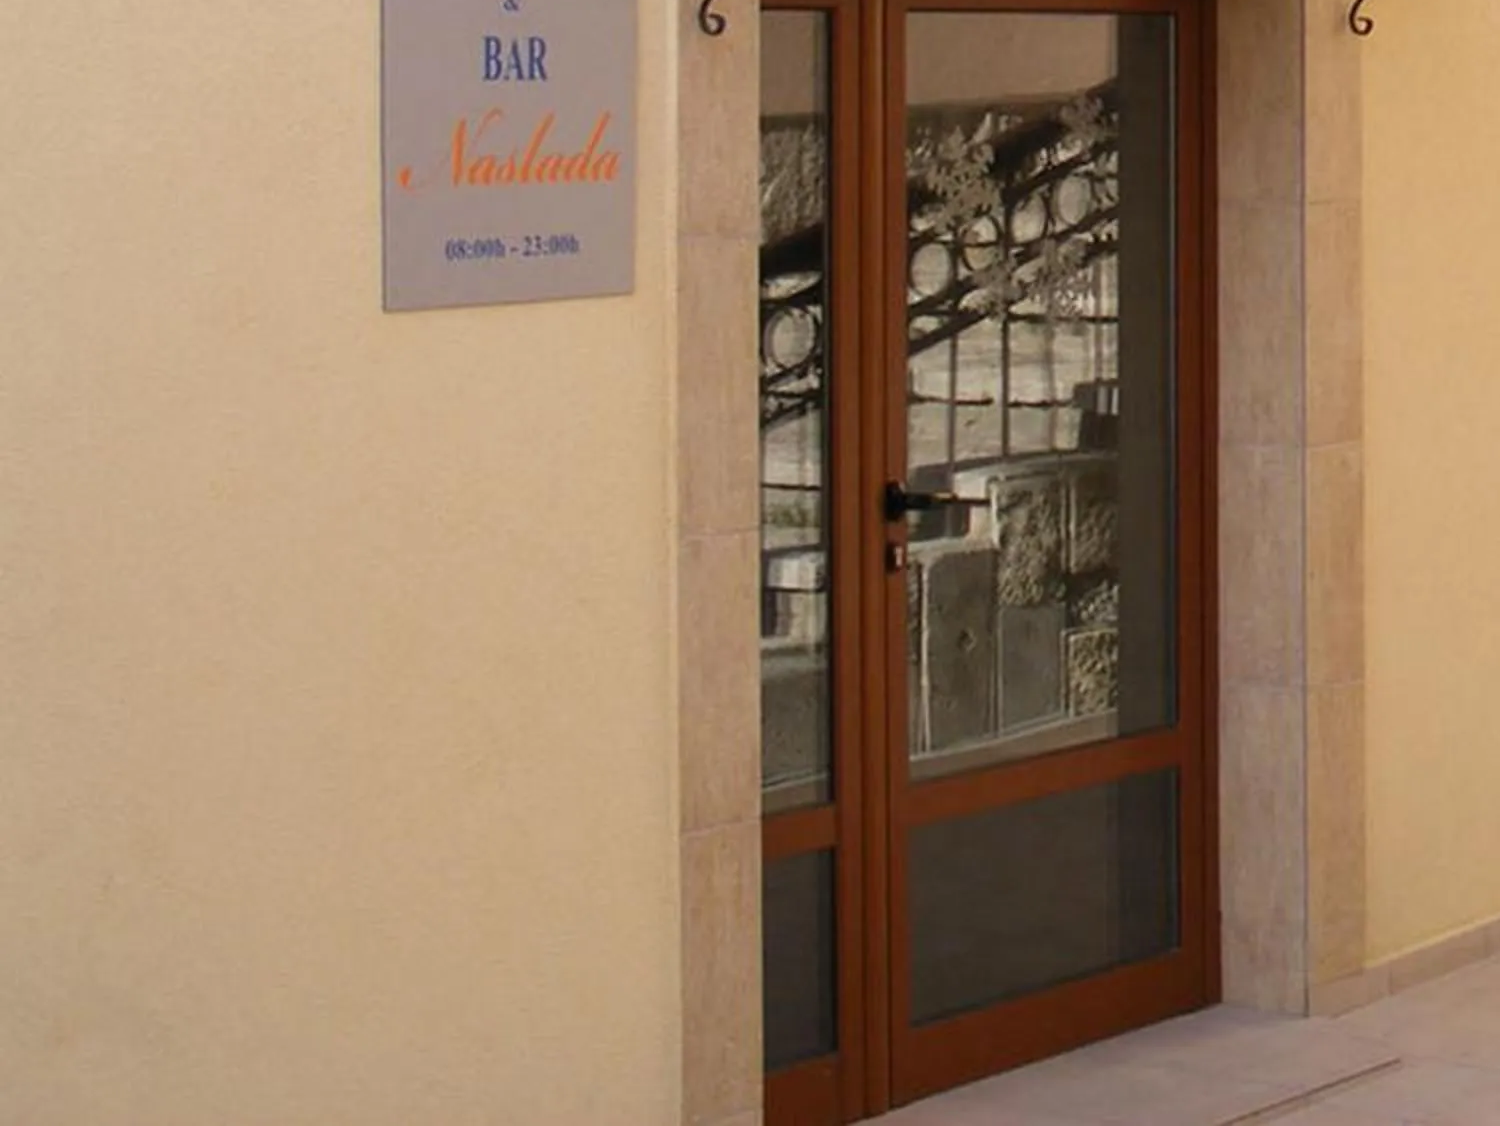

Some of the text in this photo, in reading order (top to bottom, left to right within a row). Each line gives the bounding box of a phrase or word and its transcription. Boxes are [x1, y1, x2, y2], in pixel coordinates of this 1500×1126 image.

[482, 35, 547, 81] BAR
[397, 108, 620, 196] Naslada
[445, 238, 506, 260] 08:00h
